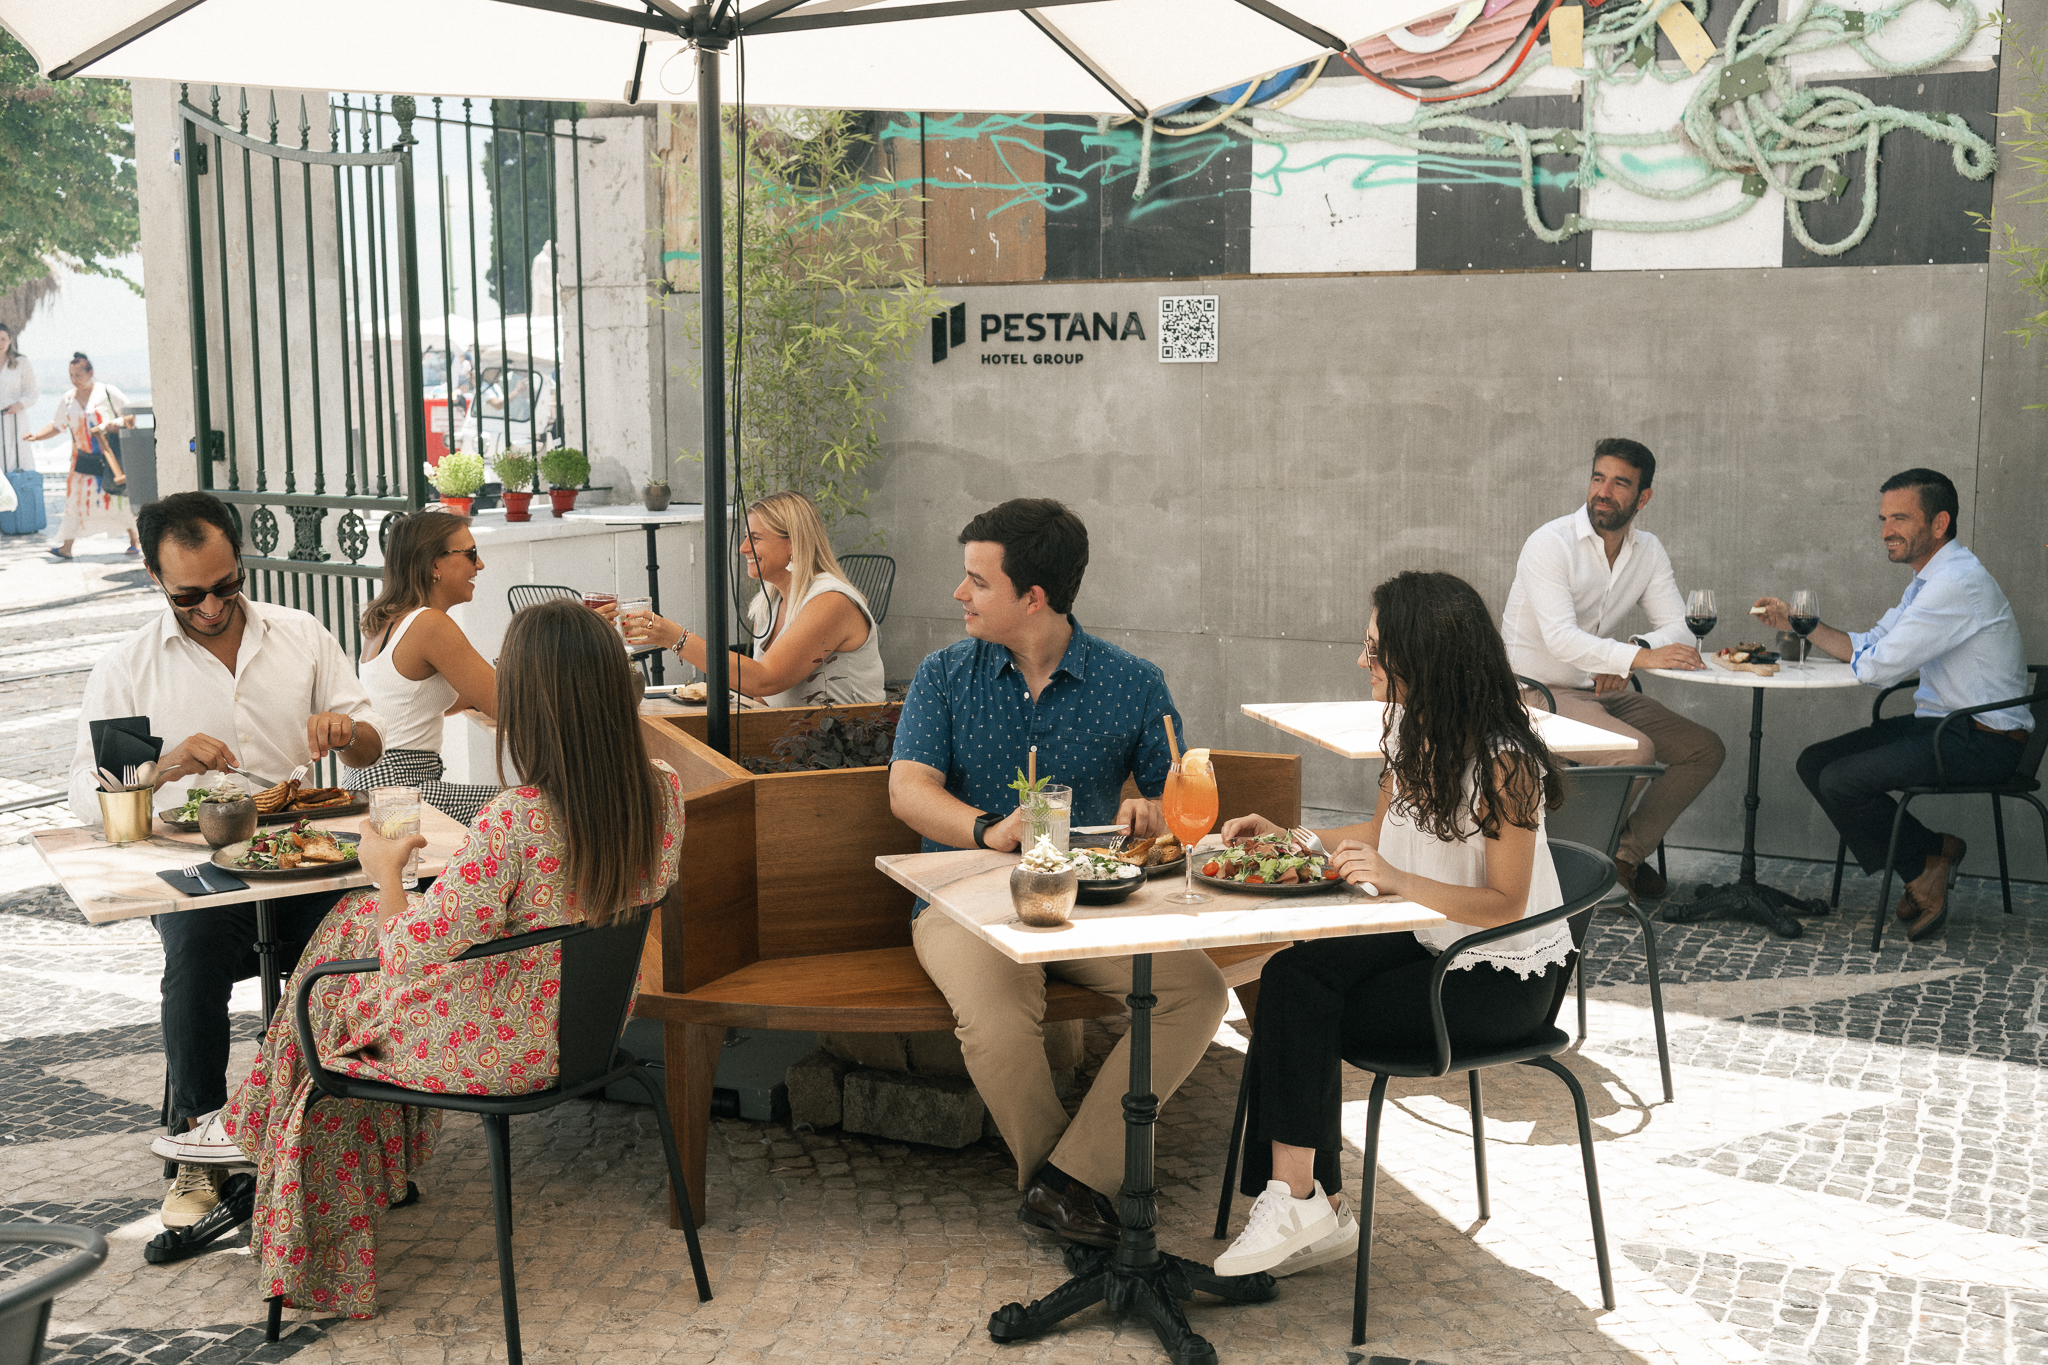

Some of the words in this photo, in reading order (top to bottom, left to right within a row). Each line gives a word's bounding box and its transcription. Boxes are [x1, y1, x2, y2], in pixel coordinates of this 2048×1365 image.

[981, 311, 1146, 342] PESTANA
[981, 353, 1028, 365] HOTEL
[1033, 353, 1084, 365] GROUP
